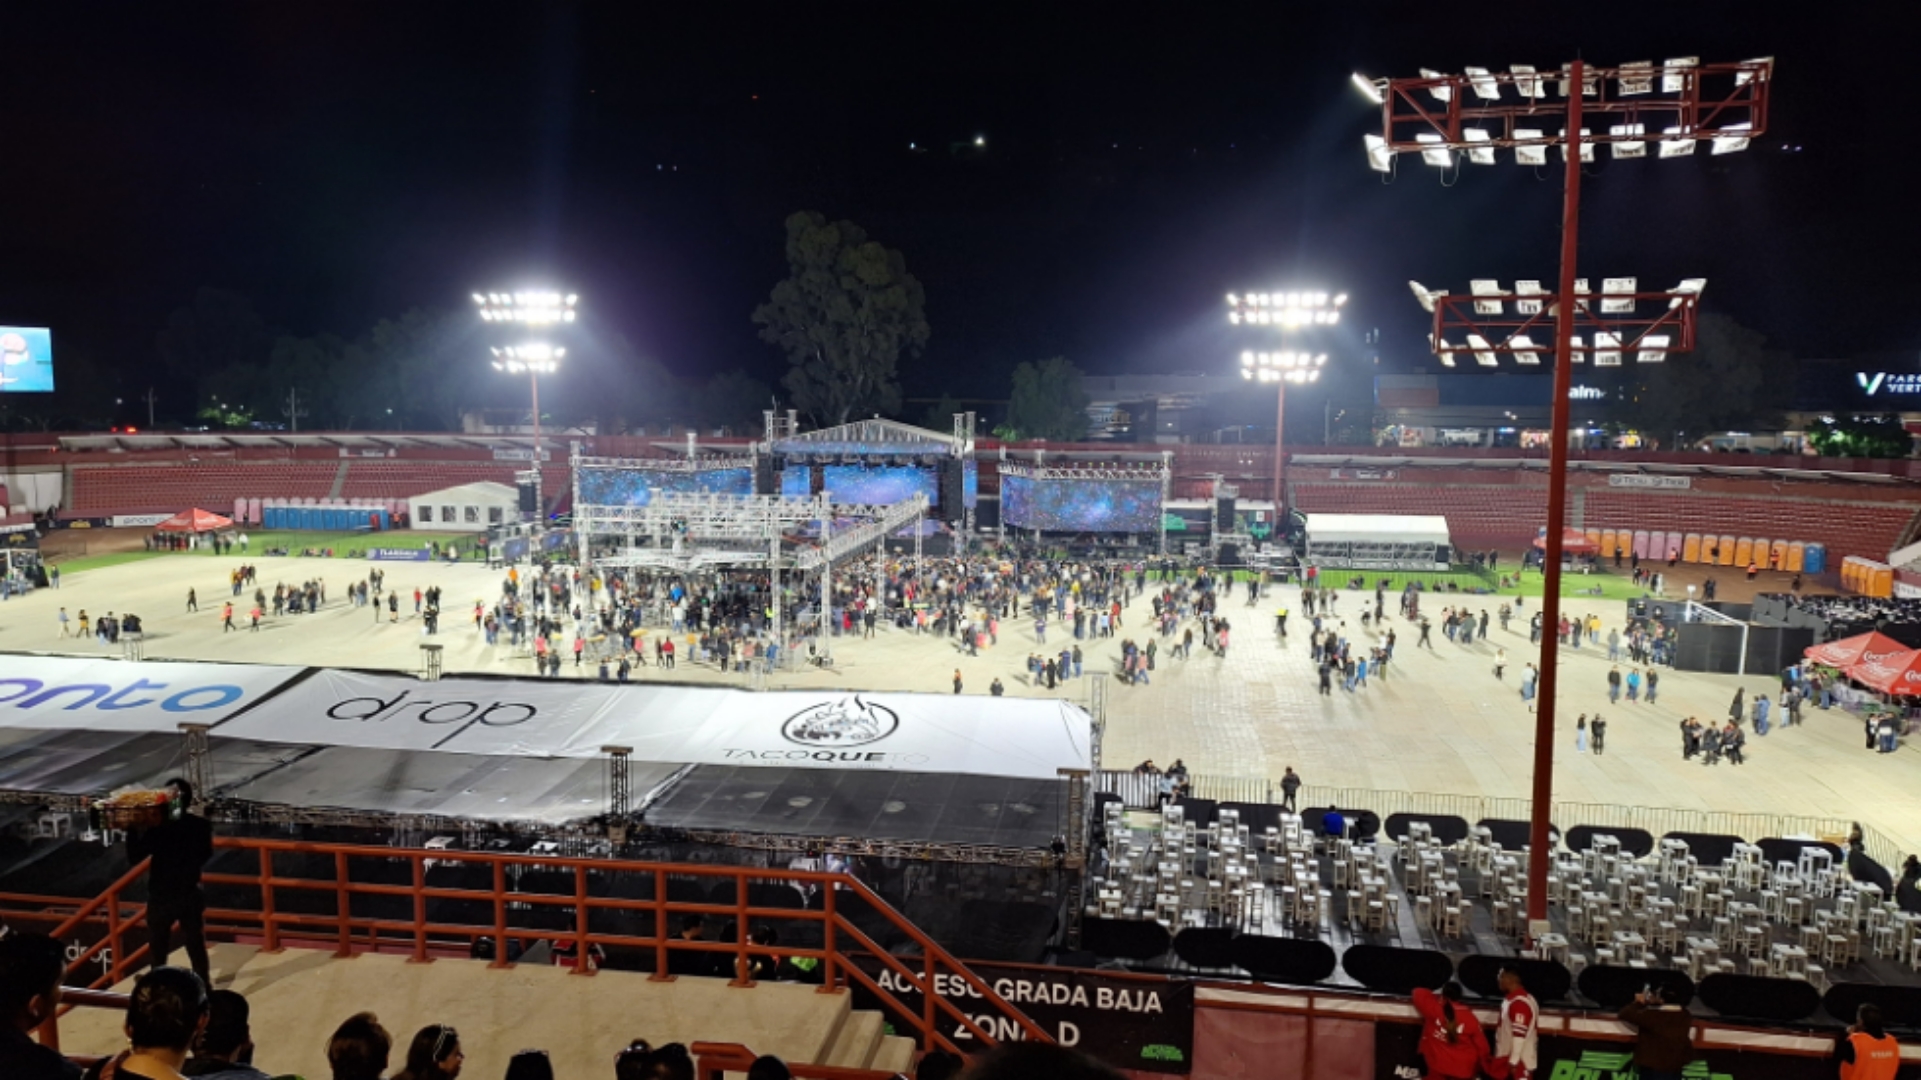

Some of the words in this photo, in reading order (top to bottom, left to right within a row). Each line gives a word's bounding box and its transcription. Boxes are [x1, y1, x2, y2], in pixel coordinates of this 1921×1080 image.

[326, 689, 537, 749] drop
[994, 979, 1089, 1008] GRADA
[1096, 987, 1162, 1014] BAJA
[1058, 1021, 1081, 1047] D
